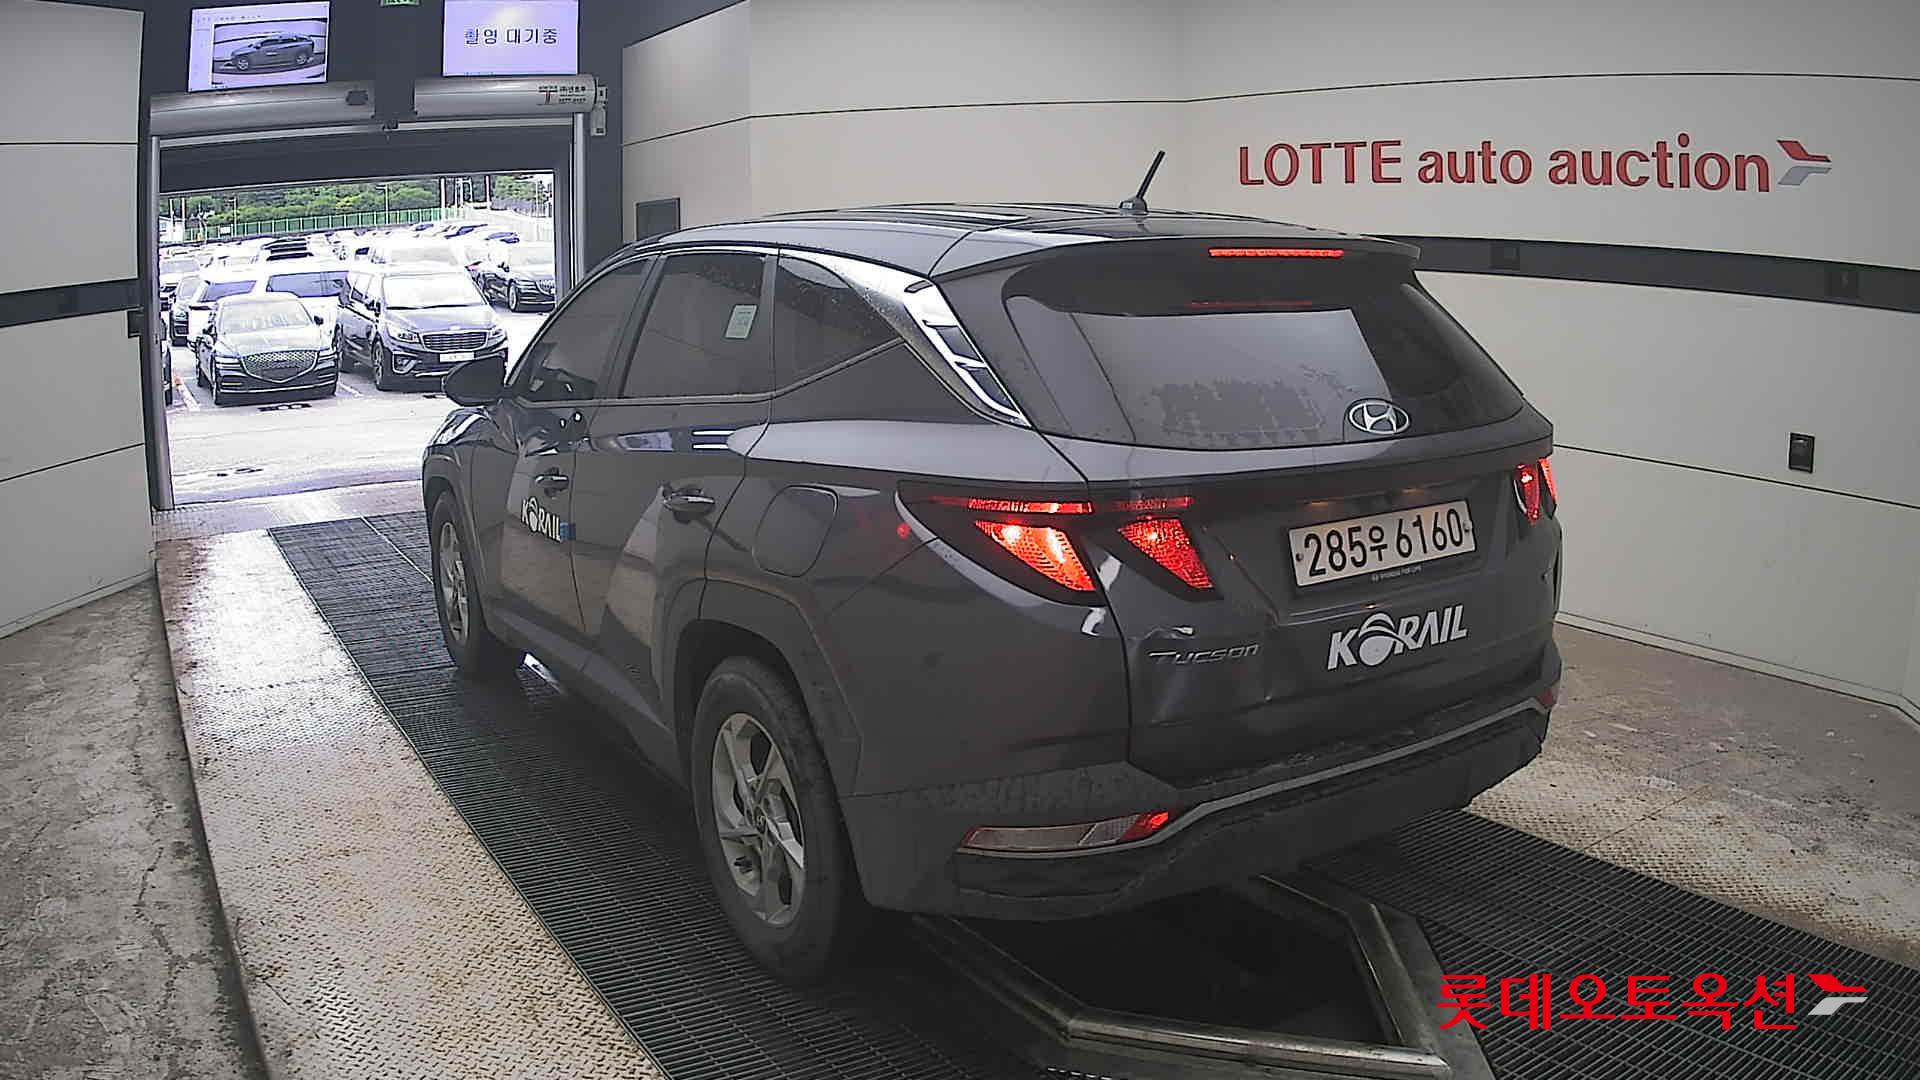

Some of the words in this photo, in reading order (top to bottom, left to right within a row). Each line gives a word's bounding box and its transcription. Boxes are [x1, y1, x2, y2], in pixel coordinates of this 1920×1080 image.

[506, 28, 558, 45] 대기중
[1239, 140, 1401, 186] LOTTE
[1417, 141, 1532, 184] auto
[1548, 133, 1770, 192] auction
[1303, 526, 1388, 577] 285우
[1396, 508, 1464, 559] 6160
[1327, 605, 1468, 670] KORAIL
